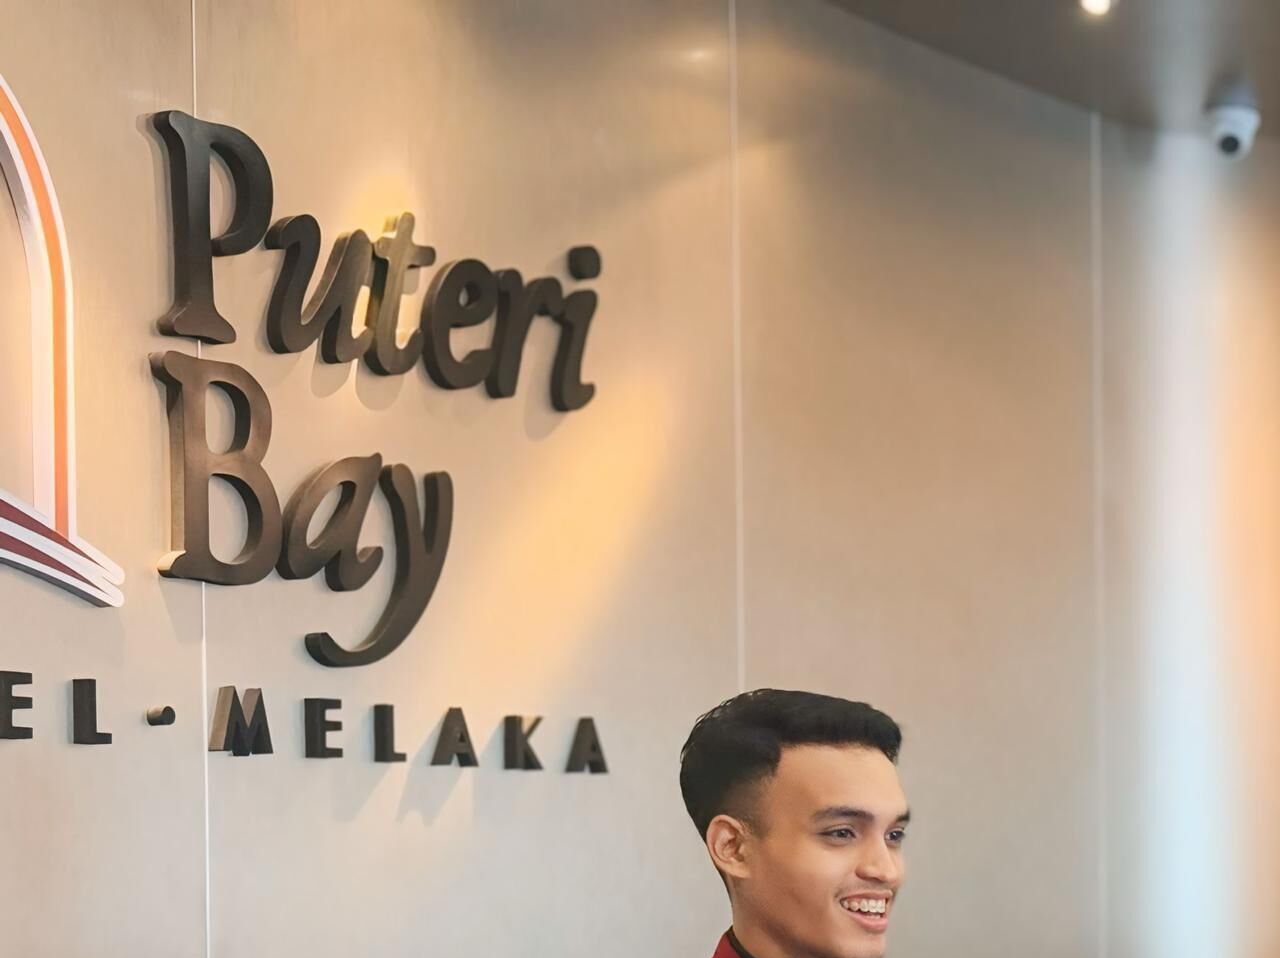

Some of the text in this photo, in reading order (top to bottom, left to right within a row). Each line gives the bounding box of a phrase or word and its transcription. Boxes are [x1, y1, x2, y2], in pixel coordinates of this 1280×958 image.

[153, 110, 601, 412] Puteri
[148, 350, 453, 667] Bay
[208, 685, 609, 774] MELAKA
